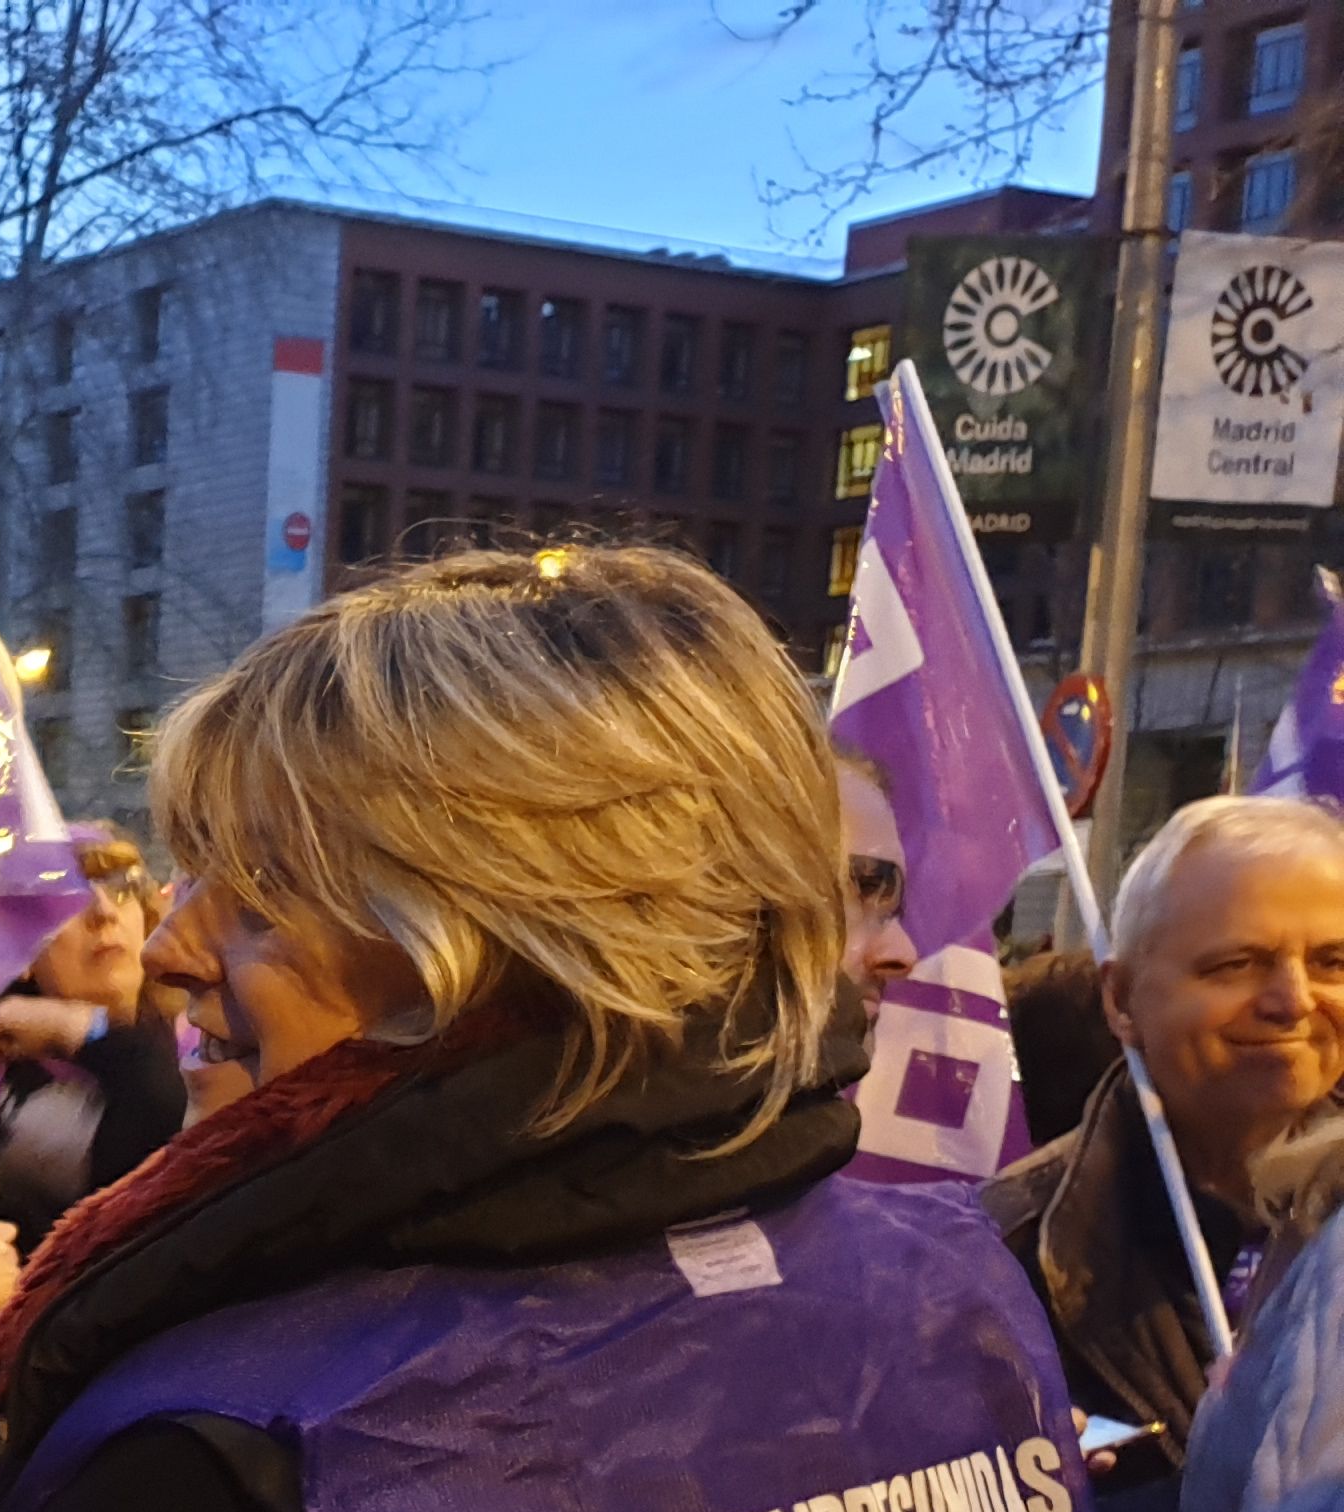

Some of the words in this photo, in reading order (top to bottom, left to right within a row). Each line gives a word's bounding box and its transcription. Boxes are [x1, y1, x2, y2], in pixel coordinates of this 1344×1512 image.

[955, 412, 1028, 442] Cuida
[1213, 417, 1296, 443] Madrid
[946, 445, 1033, 474] Madrid
[1208, 450, 1295, 476] Central
[968, 512, 1031, 533] ADRID
